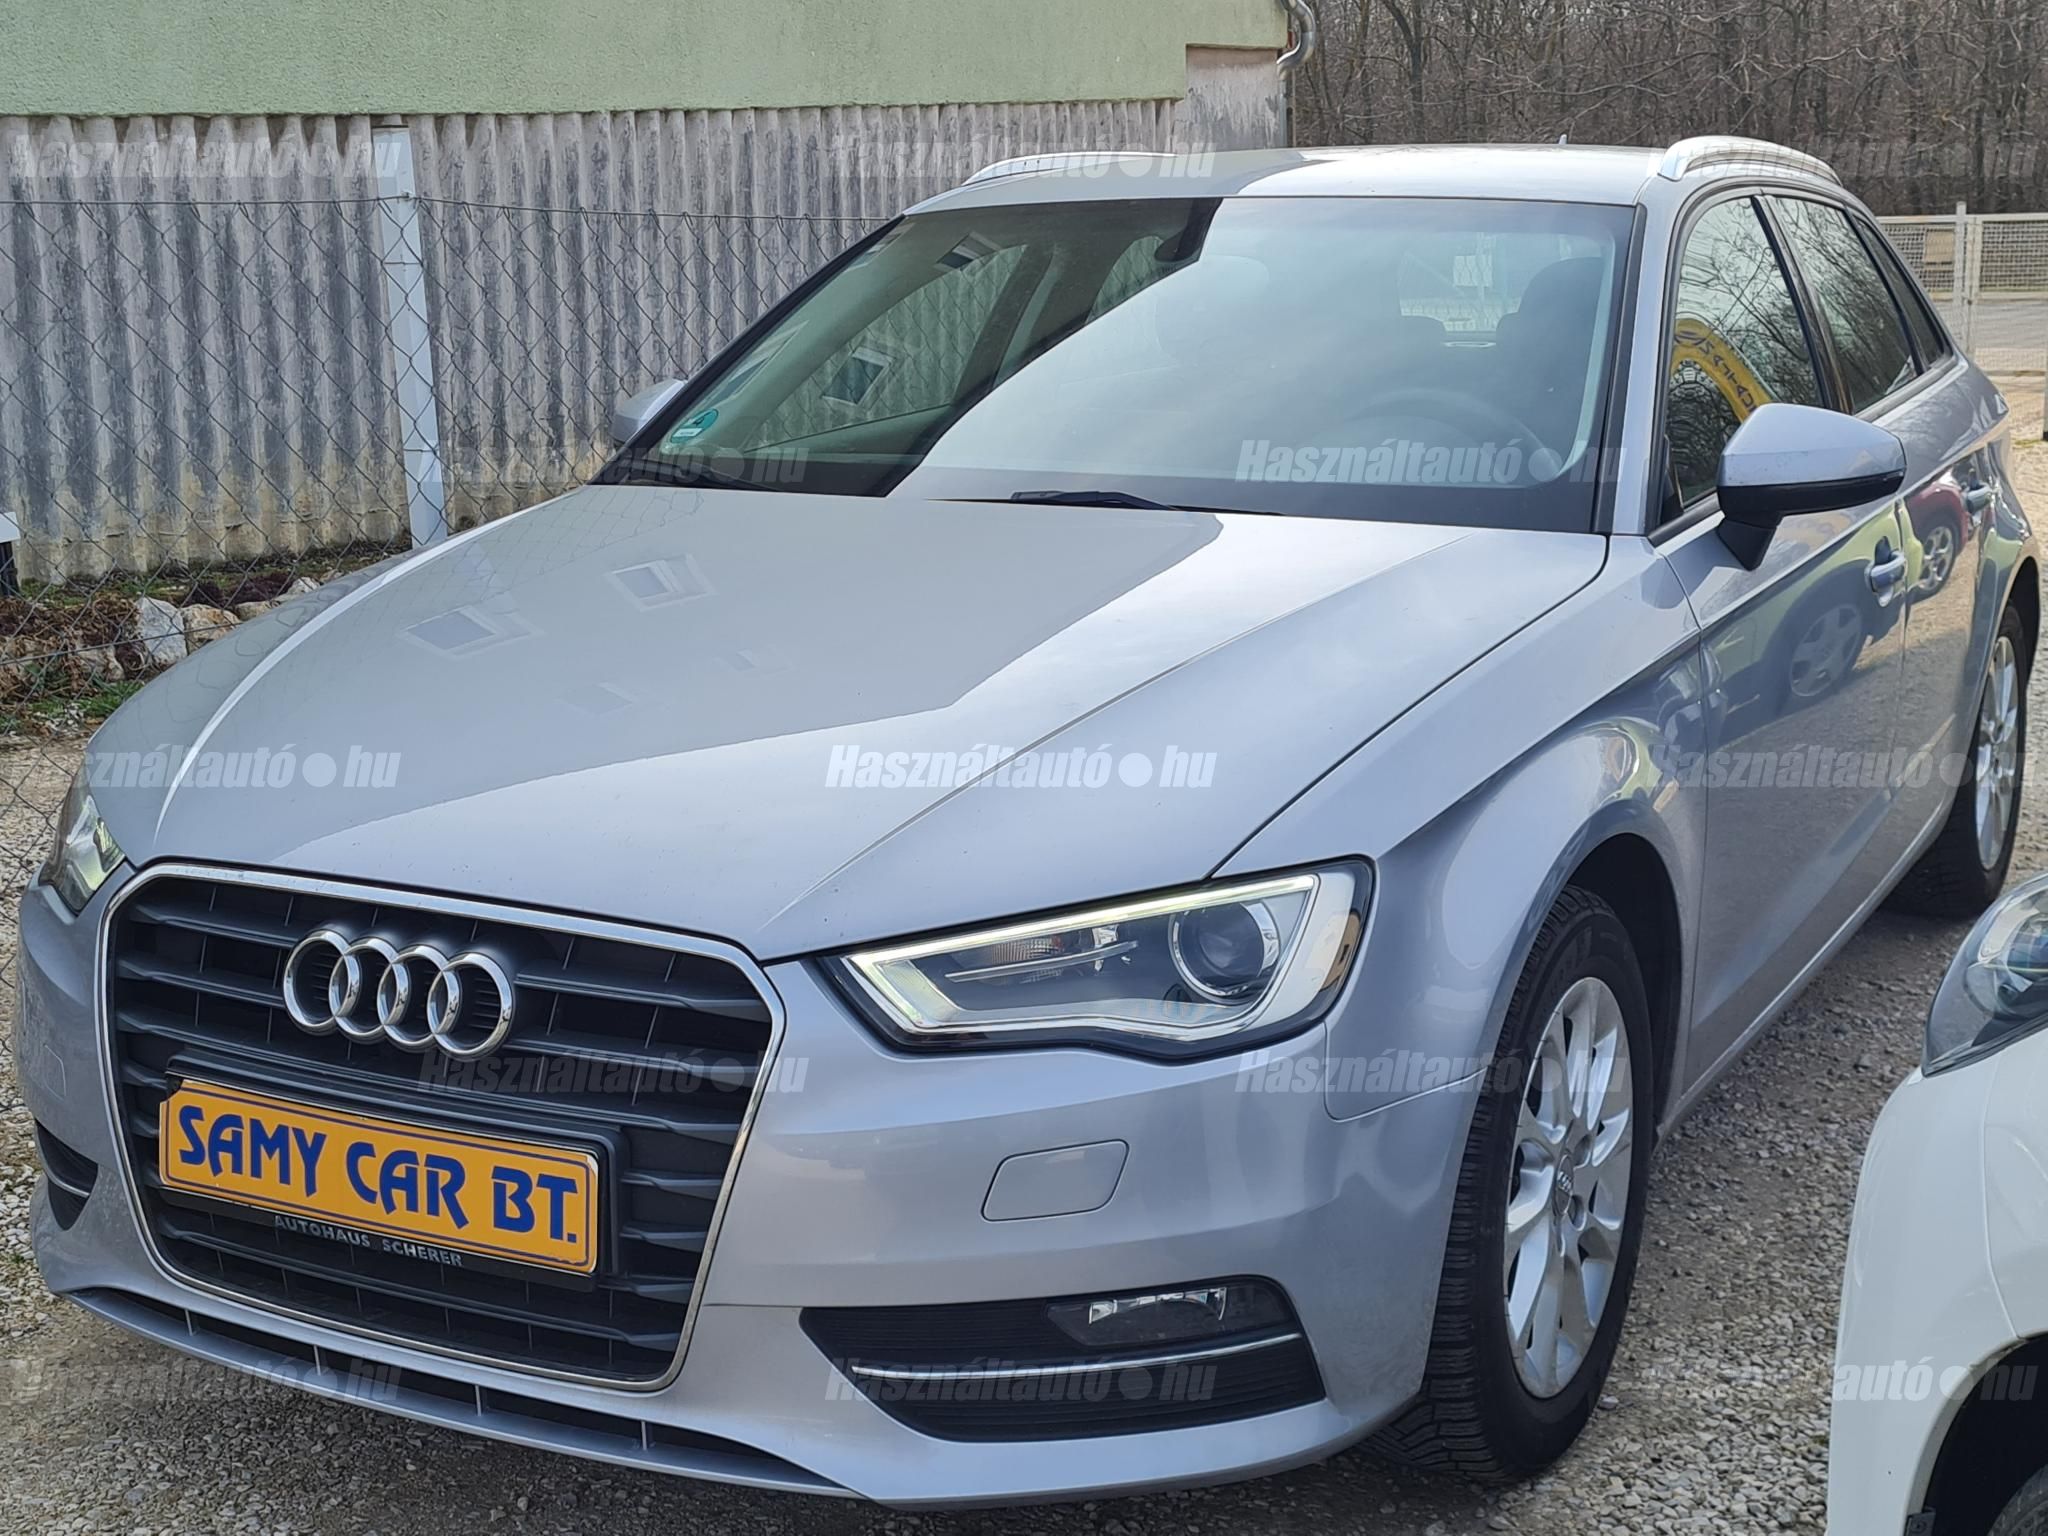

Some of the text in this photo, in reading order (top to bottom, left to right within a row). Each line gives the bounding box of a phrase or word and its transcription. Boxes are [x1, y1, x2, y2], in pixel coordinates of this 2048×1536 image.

[179, 1105, 578, 1244] SAMY CAR BT.
[274, 1214, 463, 1268] AUTOHAUS SCHERER
